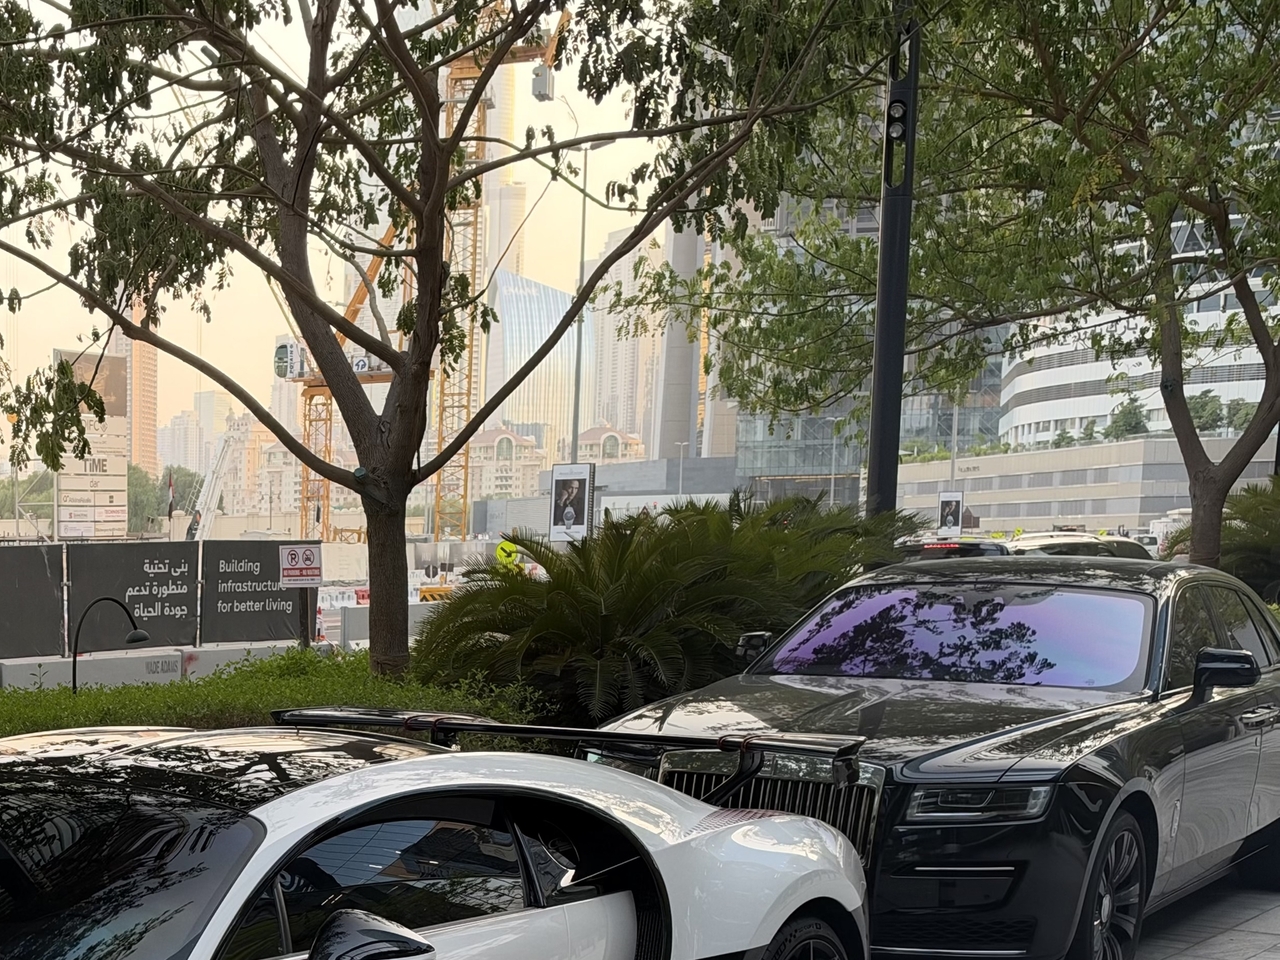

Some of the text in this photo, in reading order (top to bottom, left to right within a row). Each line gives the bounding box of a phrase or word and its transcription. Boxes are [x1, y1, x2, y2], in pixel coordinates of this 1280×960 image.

[143, 559, 189, 577] بنى تحتية
[219, 559, 261, 575] Building
[125, 580, 188, 603] متطورة تدعم
[133, 602, 188, 620] جودة الحياة
[217, 598, 293, 614] for better living
